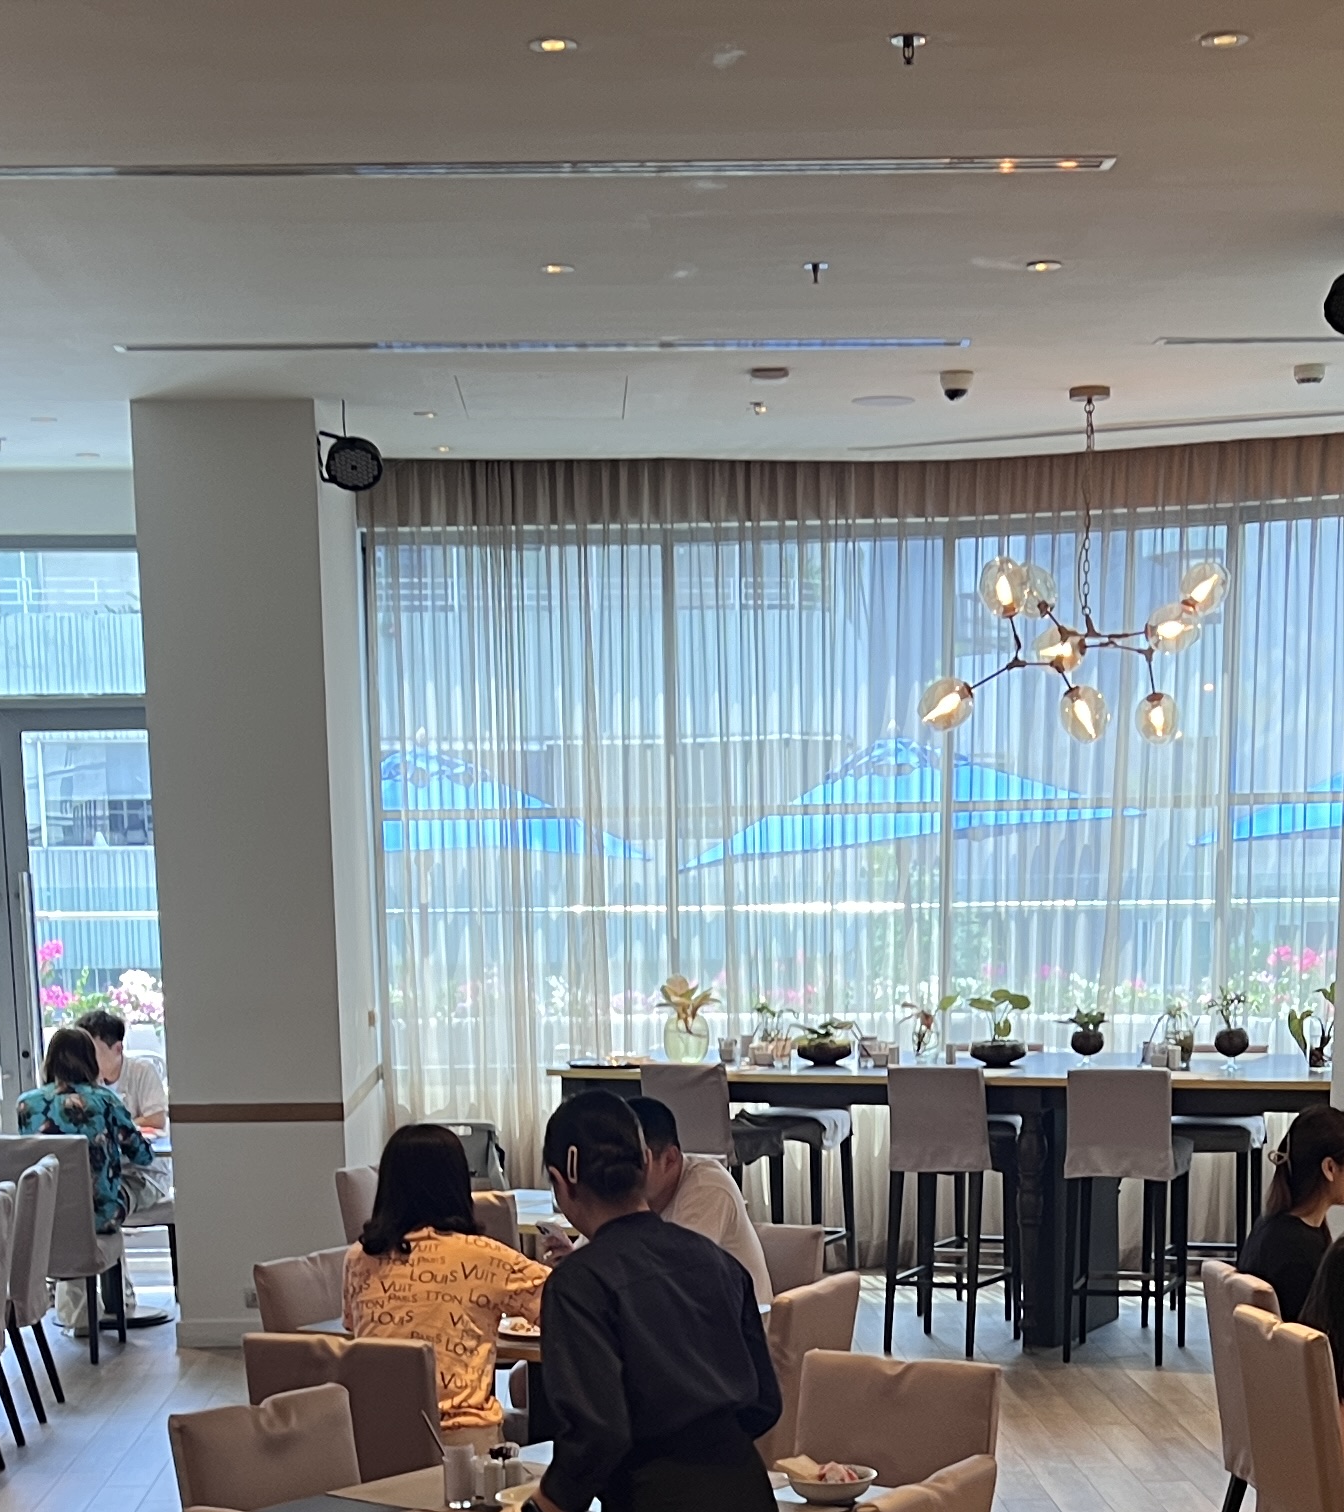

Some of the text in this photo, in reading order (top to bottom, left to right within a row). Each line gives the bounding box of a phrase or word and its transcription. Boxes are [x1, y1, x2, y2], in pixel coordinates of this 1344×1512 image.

[409, 1261, 497, 1285] LOUIS VUIT
[380, 1280, 414, 1294] VUIT
[425, 1290, 463, 1305] TTON
